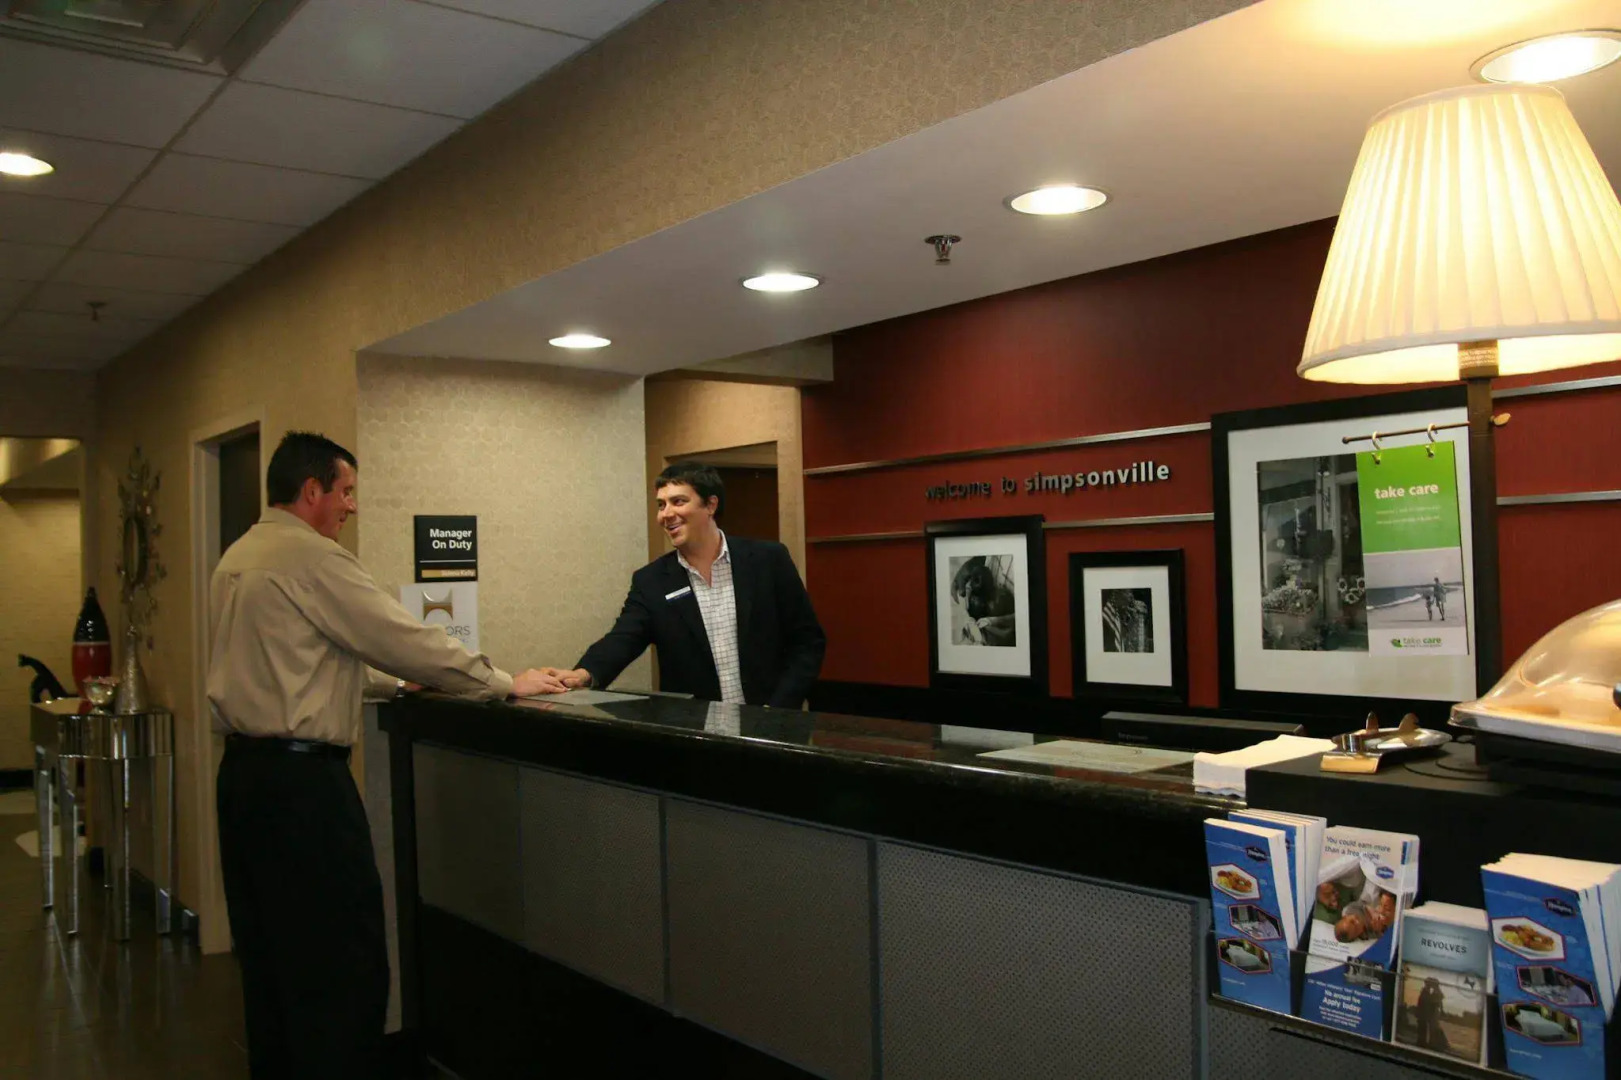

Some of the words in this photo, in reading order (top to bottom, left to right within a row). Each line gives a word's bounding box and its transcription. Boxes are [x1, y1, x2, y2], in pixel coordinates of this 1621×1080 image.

[925, 480, 991, 499] welcome
[1001, 476, 1017, 493] to
[1025, 460, 1170, 494] simpsonville
[1374, 485, 1405, 499] take
[1408, 484, 1439, 496] care
[429, 528, 472, 539] Manager
[432, 541, 447, 549] On
[448, 540, 472, 551] Duty
[1326, 836, 1338, 844] You
[1339, 839, 1356, 847] could
[1324, 845, 1340, 853] than
[1421, 937, 1467, 953] REVOLVES
[1323, 997, 1341, 1008] Apply
[1342, 1002, 1362, 1013] today
